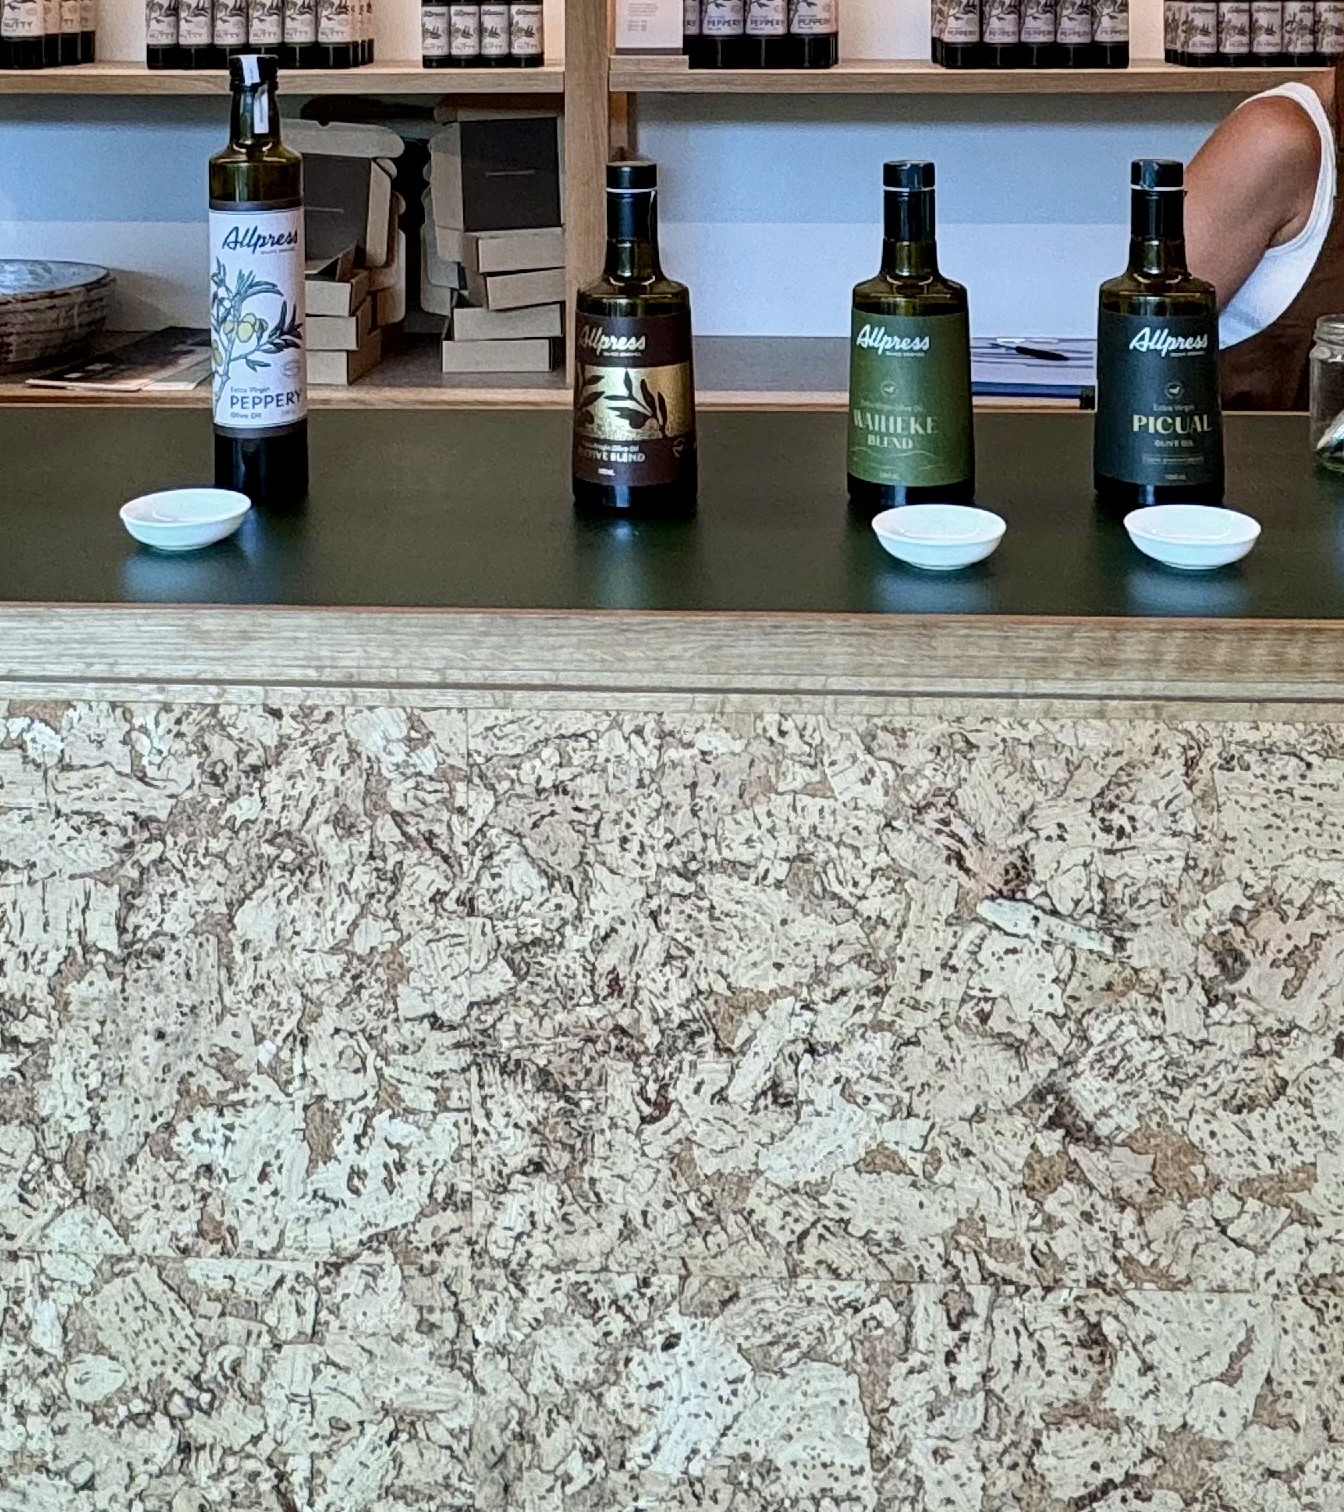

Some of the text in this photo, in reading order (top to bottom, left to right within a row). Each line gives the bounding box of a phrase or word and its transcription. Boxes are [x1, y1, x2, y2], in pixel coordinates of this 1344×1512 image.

[222, 225, 298, 254] Allpress
[578, 325, 646, 356] Allpress
[856, 324, 930, 356] Allpress
[1129, 326, 1208, 357] Allpress
[230, 389, 301, 410] PEPPERY
[854, 409, 938, 435] WAIHEKE
[1133, 414, 1213, 434] PICUAL
[868, 434, 914, 449] BLEND
[610, 452, 646, 462] BLEND
